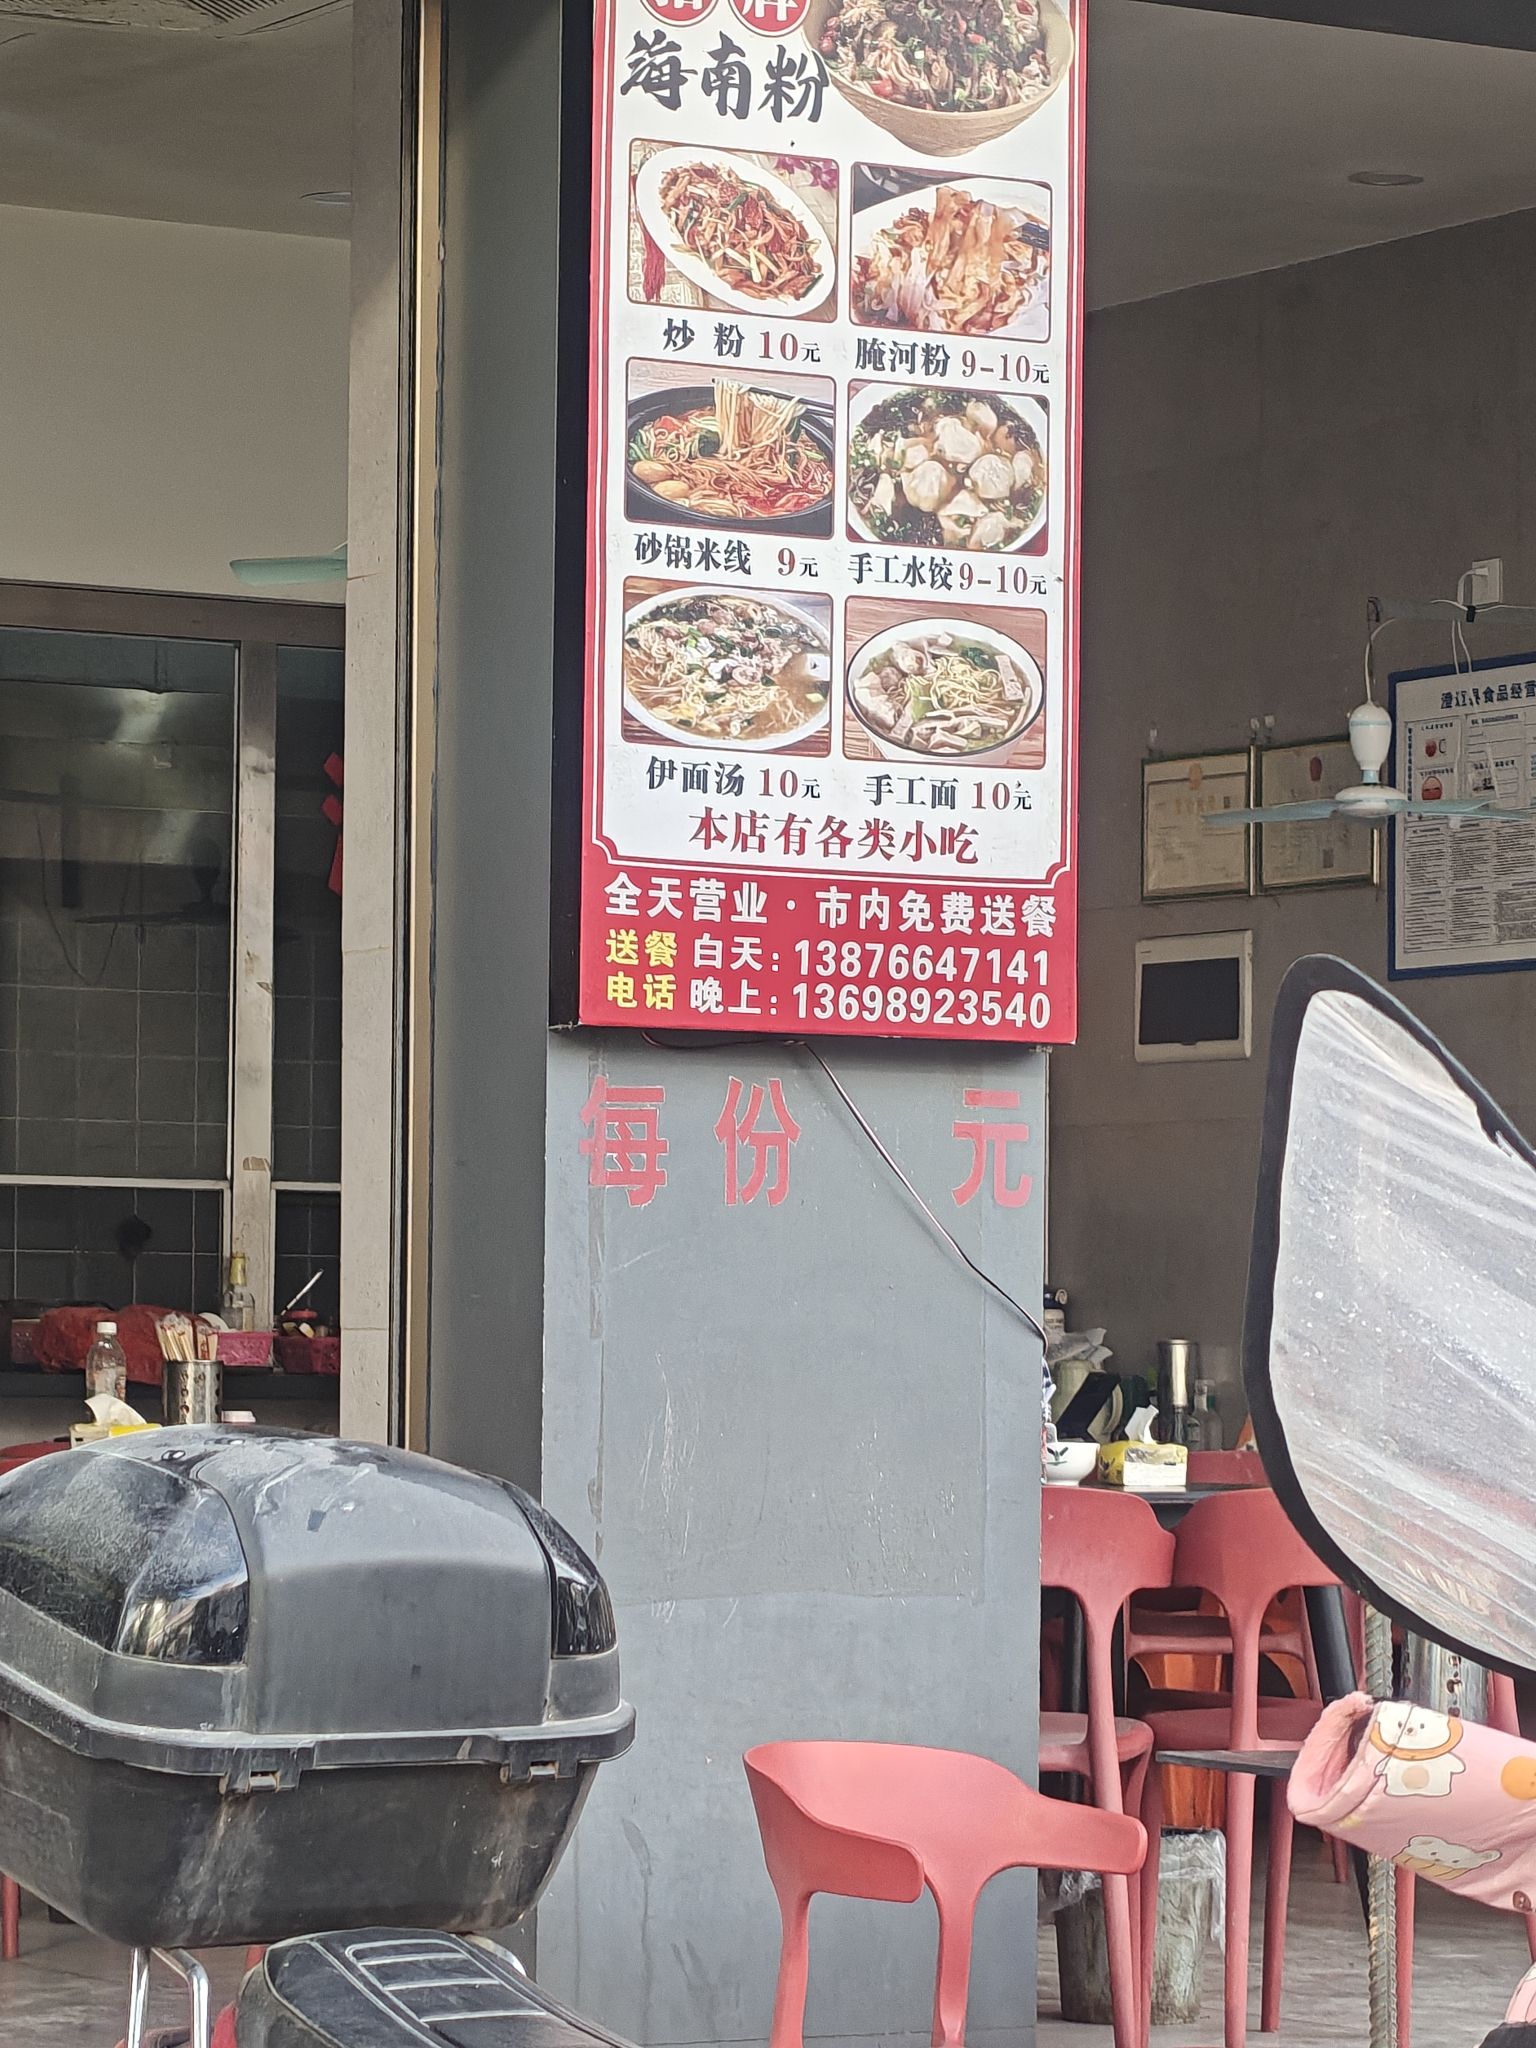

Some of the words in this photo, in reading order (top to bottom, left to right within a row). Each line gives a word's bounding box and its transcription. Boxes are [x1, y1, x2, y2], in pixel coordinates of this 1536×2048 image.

[620, 29, 830, 123] 海南粉
[634, 533, 752, 575] 砂锅米线
[646, 756, 744, 797] 伊面汤
[863, 774, 957, 810] 手工面
[689, 807, 980, 864] 本店有各类小吃
[606, 928, 678, 968] 送餐
[606, 971, 677, 1011] 电话
[579, 1075, 669, 1208] 每
[714, 1076, 801, 1207] 份
[951, 1088, 1033, 1208] 元
